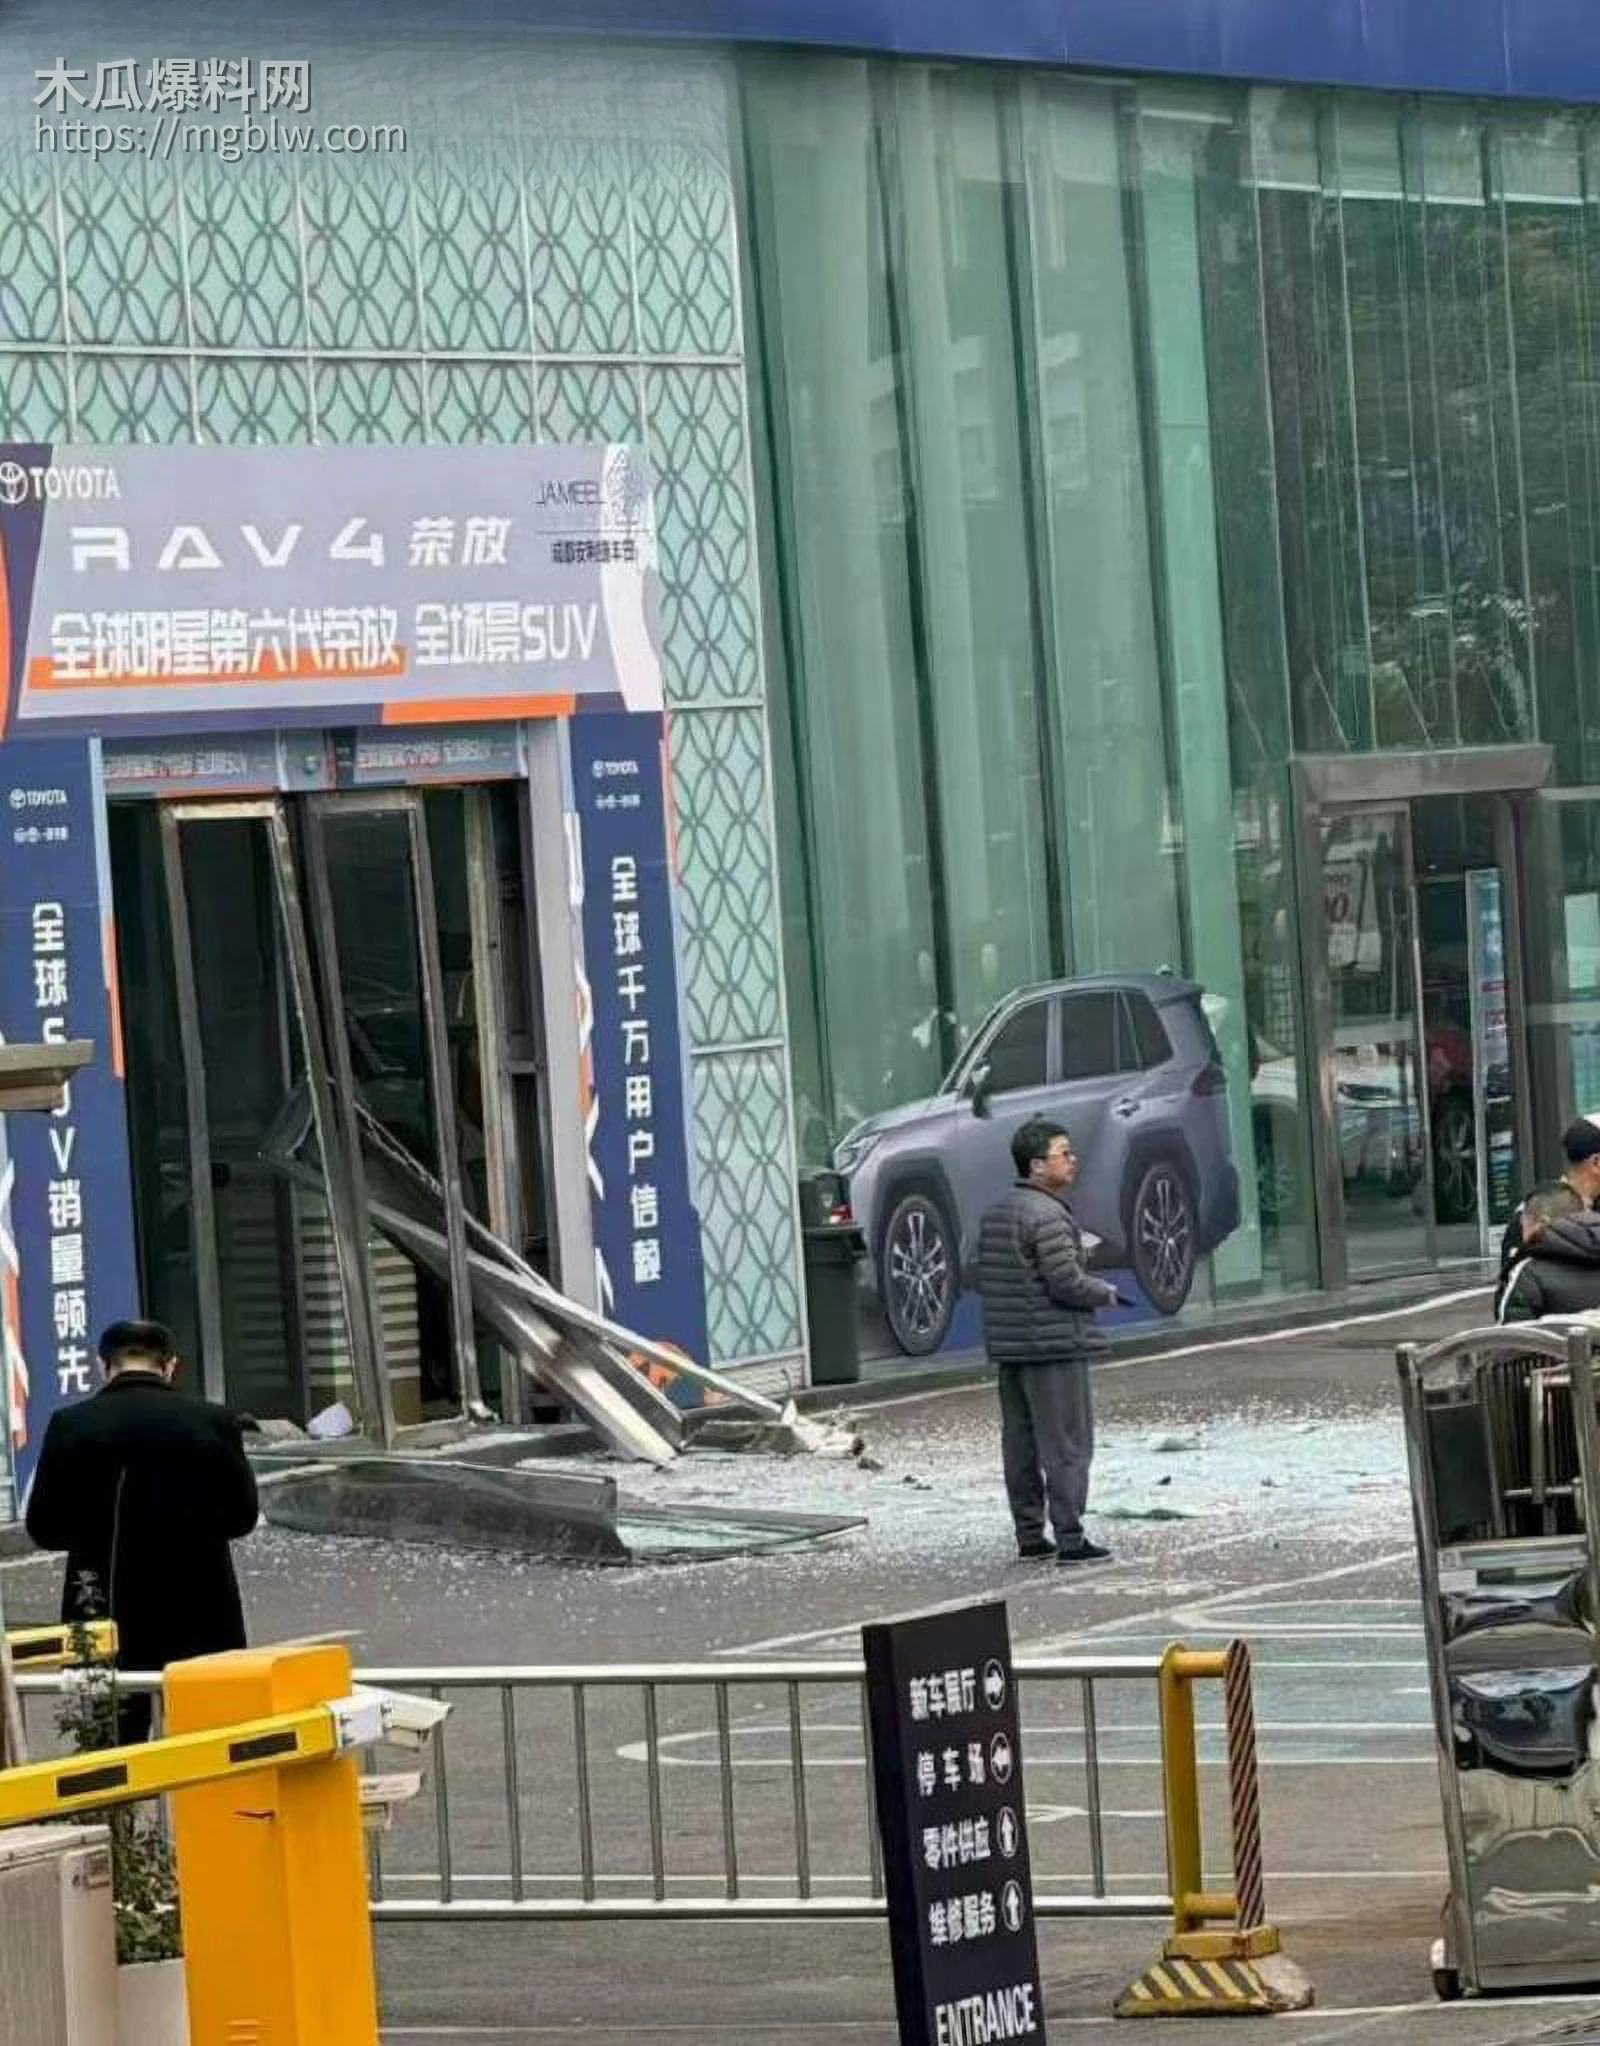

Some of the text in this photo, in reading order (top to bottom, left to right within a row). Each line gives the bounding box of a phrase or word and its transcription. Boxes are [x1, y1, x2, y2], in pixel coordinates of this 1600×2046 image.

[29, 467, 121, 499] TOYOTA
[407, 514, 512, 566] 荣放
[50, 601, 598, 679] 全球明星第六代荣放 全场景SUV
[27, 789, 67, 806] TOYOTA
[909, 1667, 976, 1721] 新车展厅
[916, 1742, 986, 1797] 停车场
[922, 1814, 991, 1871] 零件供应
[928, 1890, 996, 1946] 维修服务
[934, 1982, 1037, 2046] ENTRANCE
